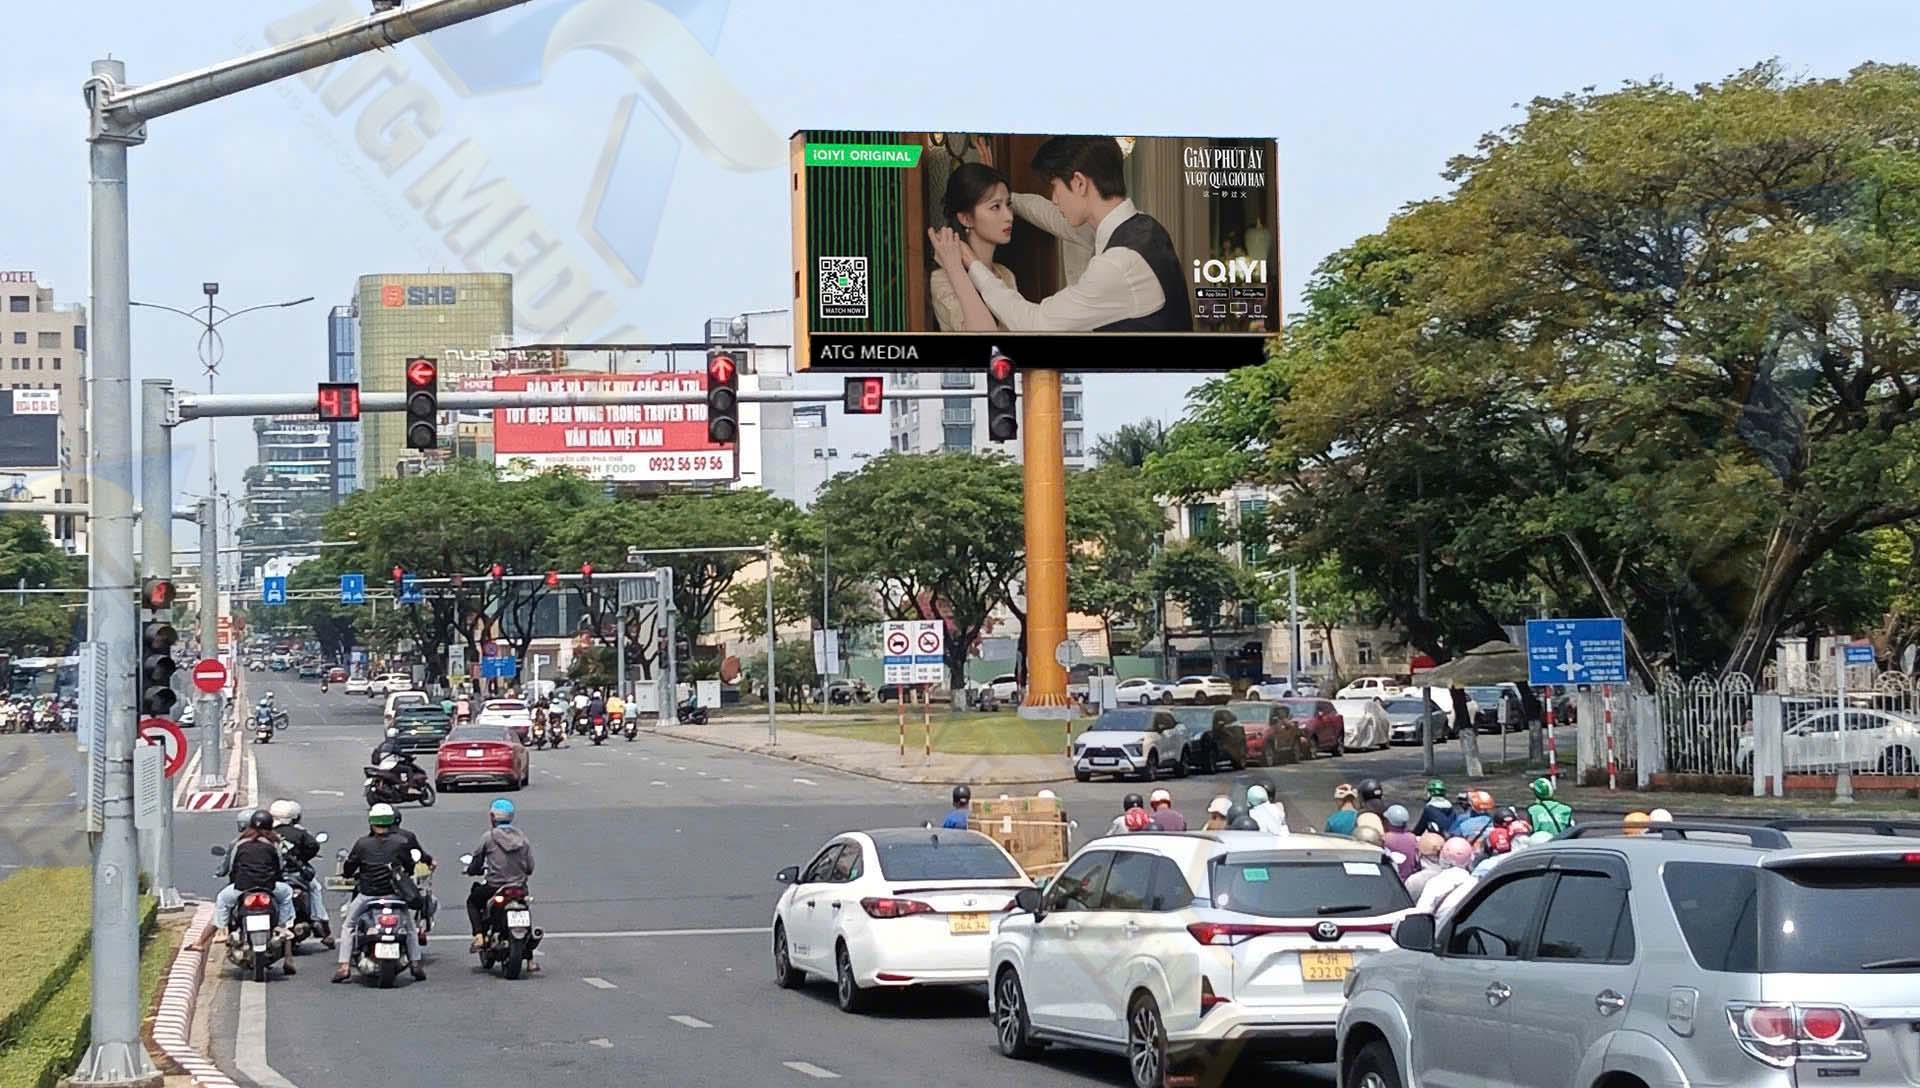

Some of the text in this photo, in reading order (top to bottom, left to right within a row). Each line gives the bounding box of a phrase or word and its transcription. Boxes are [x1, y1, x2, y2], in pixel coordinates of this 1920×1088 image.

[813, 149, 911, 162] iQIYI ORIGINAL
[1213, 146, 1247, 169] PHÚT
[1184, 171, 1208, 187] VƯỢT
[1193, 258, 1267, 284] iQIYI
[407, 286, 457, 306] SHB
[820, 345, 919, 360] ATG MEDIA
[863, 381, 881, 410] 2
[612, 427, 637, 450] VIỆT
[638, 428, 664, 447] NAM
[605, 463, 636, 474] FOOD
[649, 455, 723, 472] 0932 56 59 56
